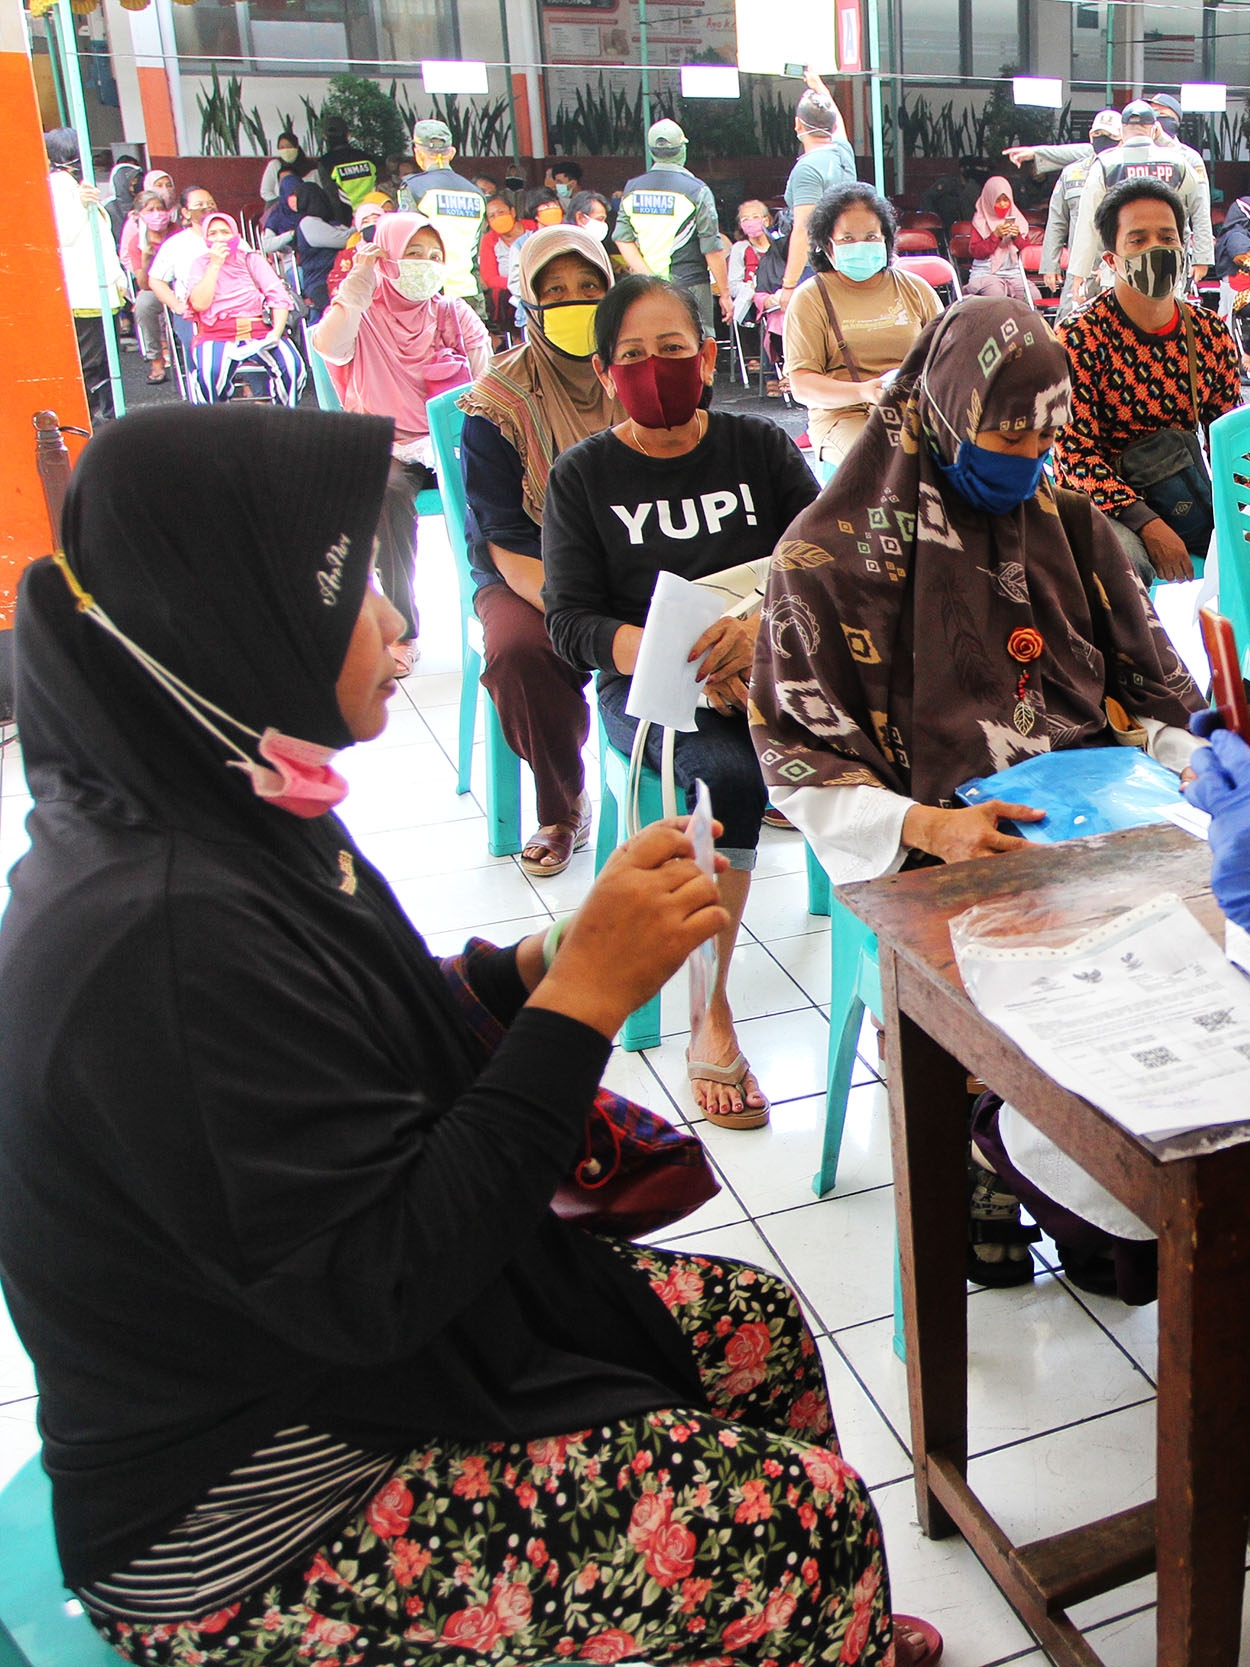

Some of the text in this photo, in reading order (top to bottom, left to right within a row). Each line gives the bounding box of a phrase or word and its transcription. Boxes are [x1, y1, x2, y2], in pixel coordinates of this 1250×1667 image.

[845, 11, 855, 58] A
[339, 163, 370, 177] LINMAS
[1126, 165, 1173, 182] POL-PP
[438, 194, 480, 211] LINMAS
[633, 194, 674, 208] LINMAS
[609, 483, 758, 545] YUP!
